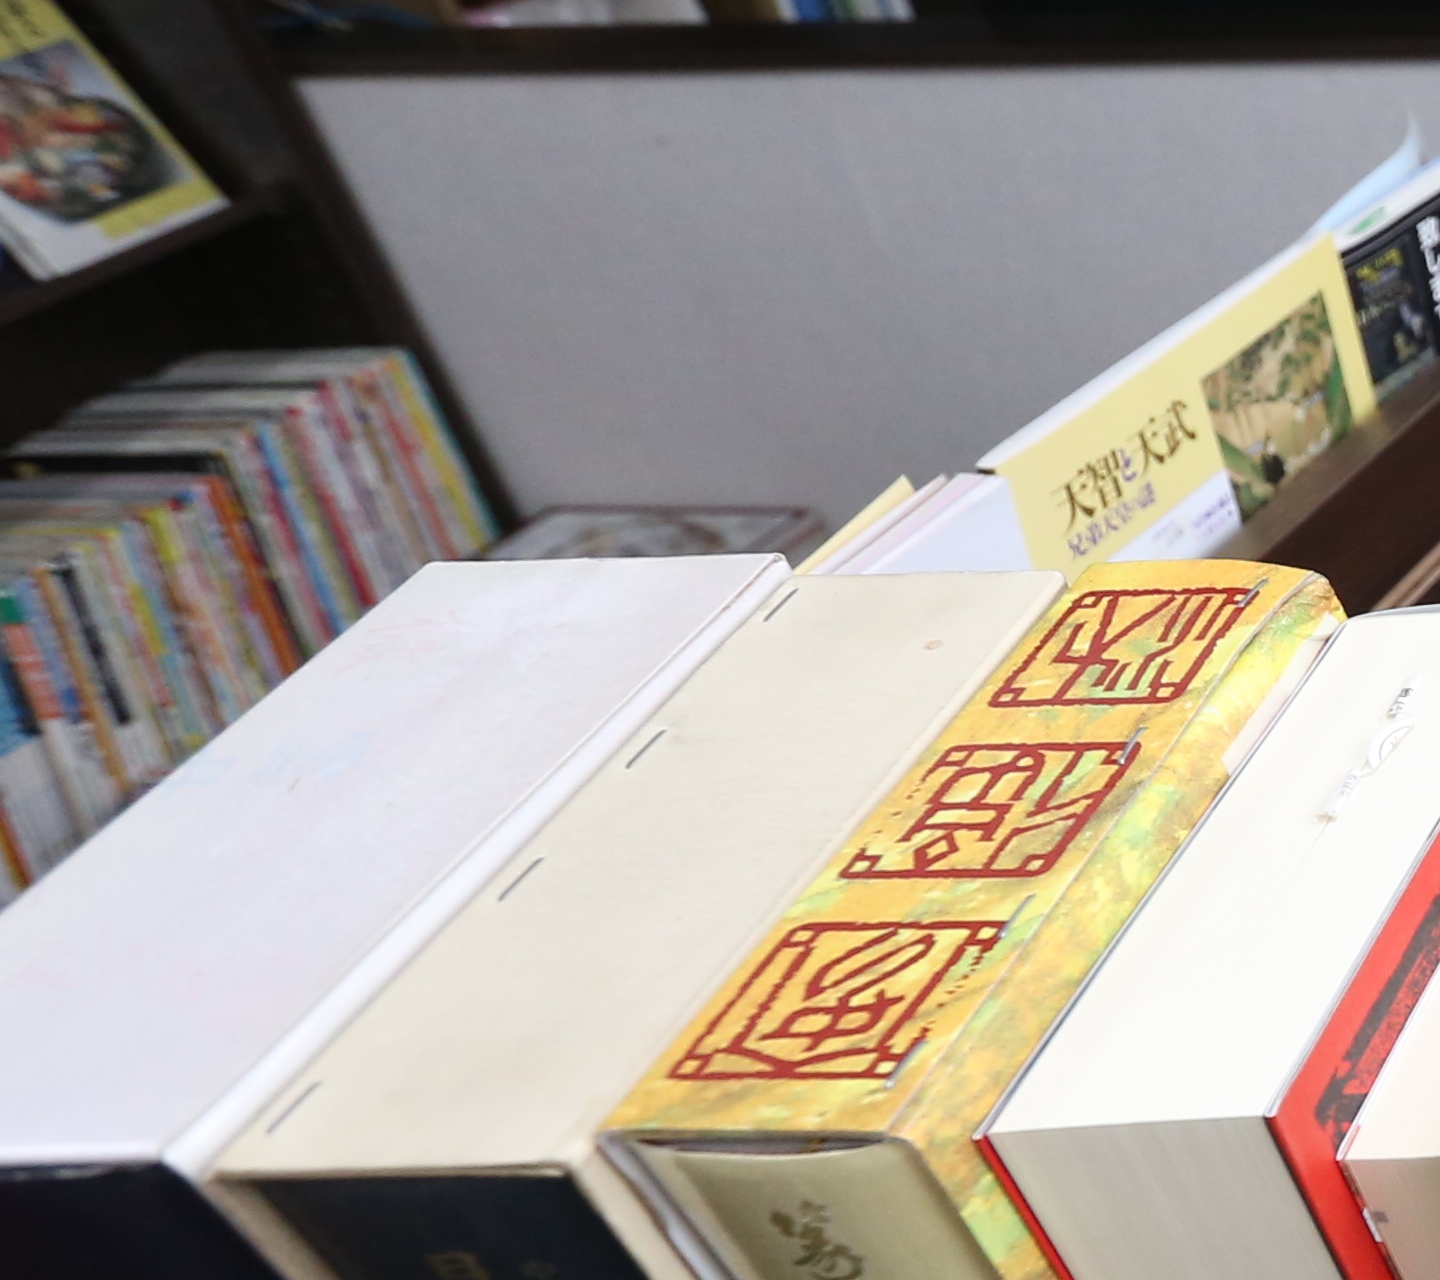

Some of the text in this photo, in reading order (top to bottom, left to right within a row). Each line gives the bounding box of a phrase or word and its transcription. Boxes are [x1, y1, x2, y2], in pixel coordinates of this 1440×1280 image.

[1051, 399, 1197, 534] 天智と天武
